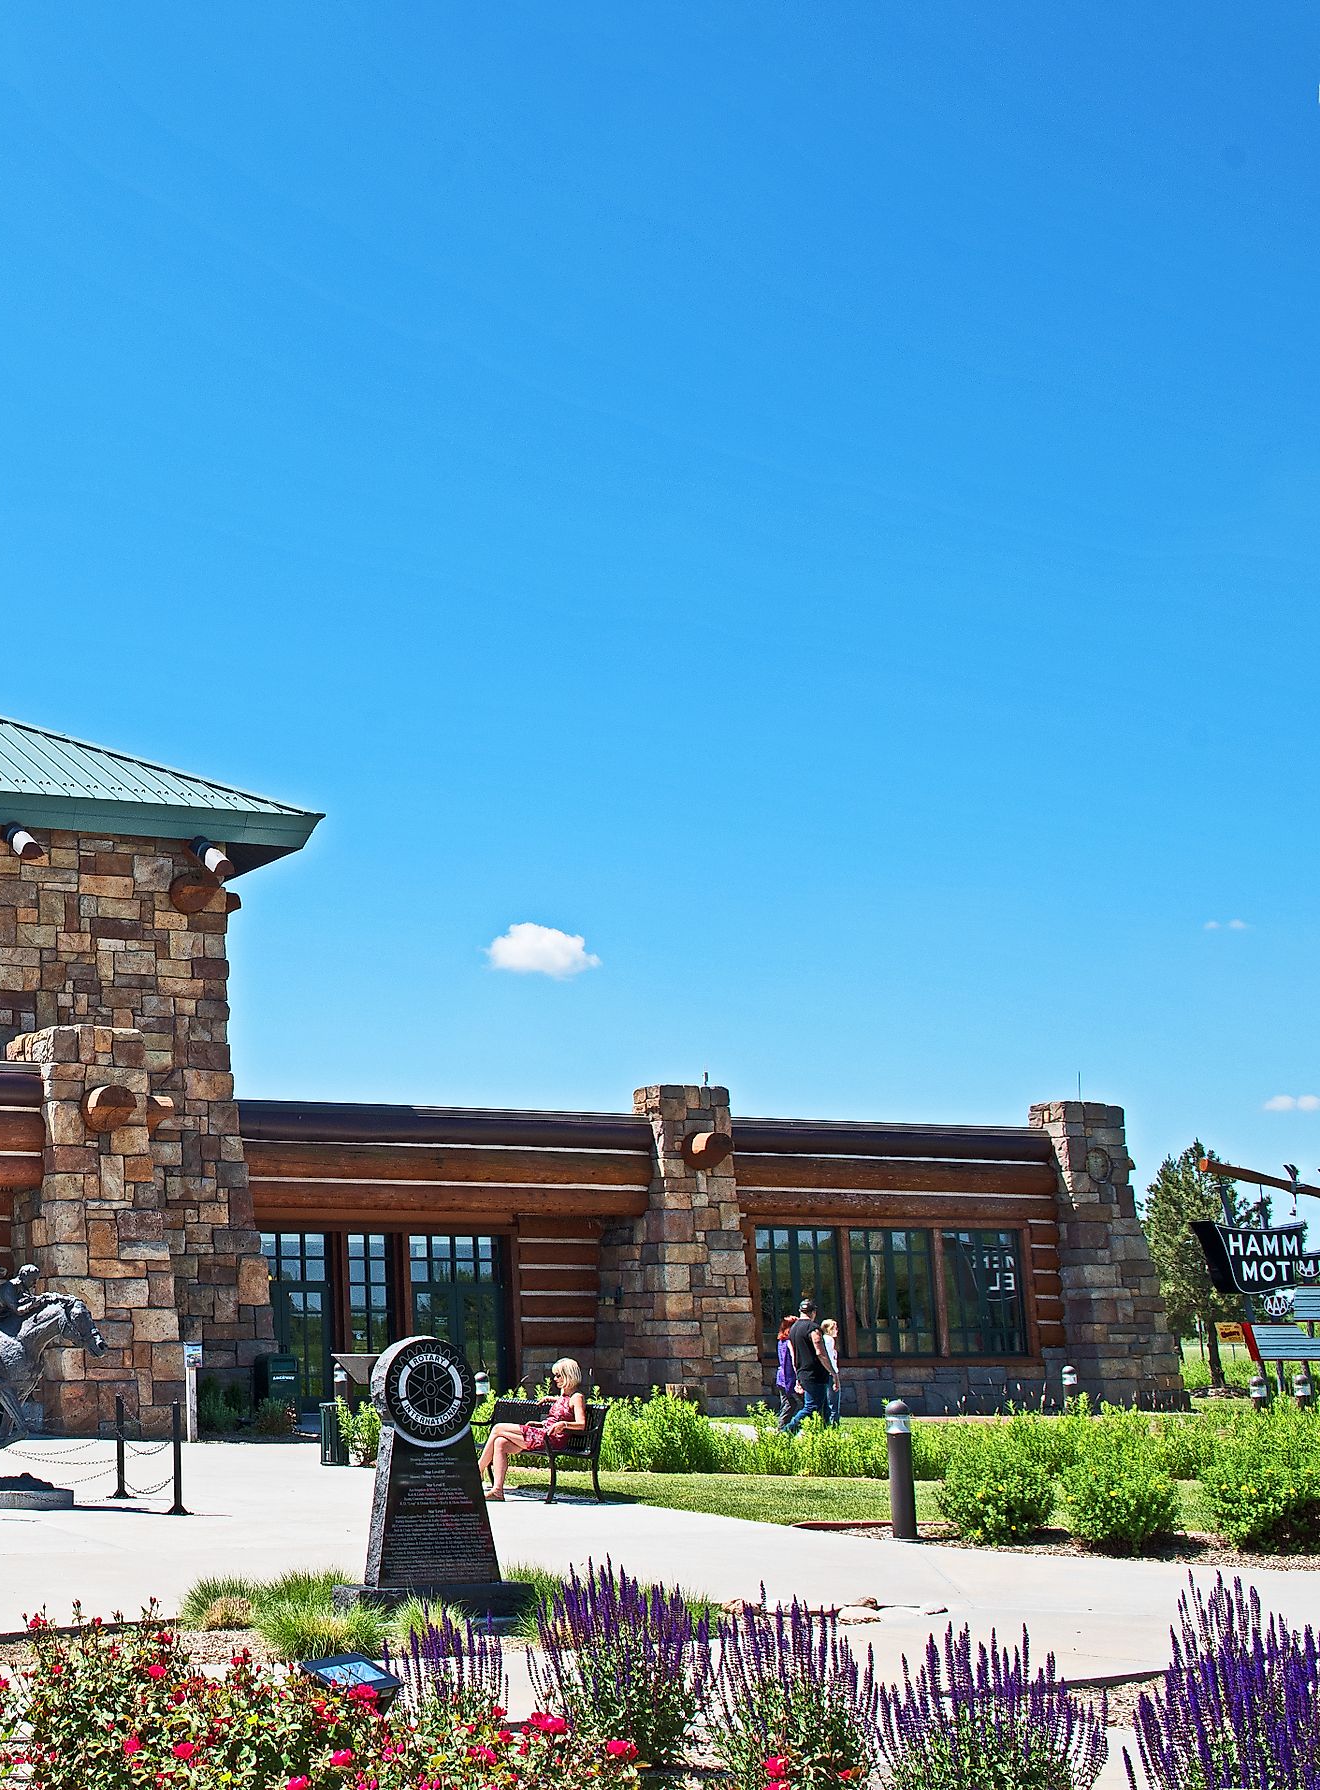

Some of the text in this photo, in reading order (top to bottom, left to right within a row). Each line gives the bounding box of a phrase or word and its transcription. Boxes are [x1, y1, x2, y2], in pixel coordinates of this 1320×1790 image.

[1228, 1233, 1299, 1256] HAMM
[1265, 1295, 1289, 1316] AAA
[413, 1354, 446, 1365] ROTARY
[404, 1402, 459, 1426] INTERNATIONAL
